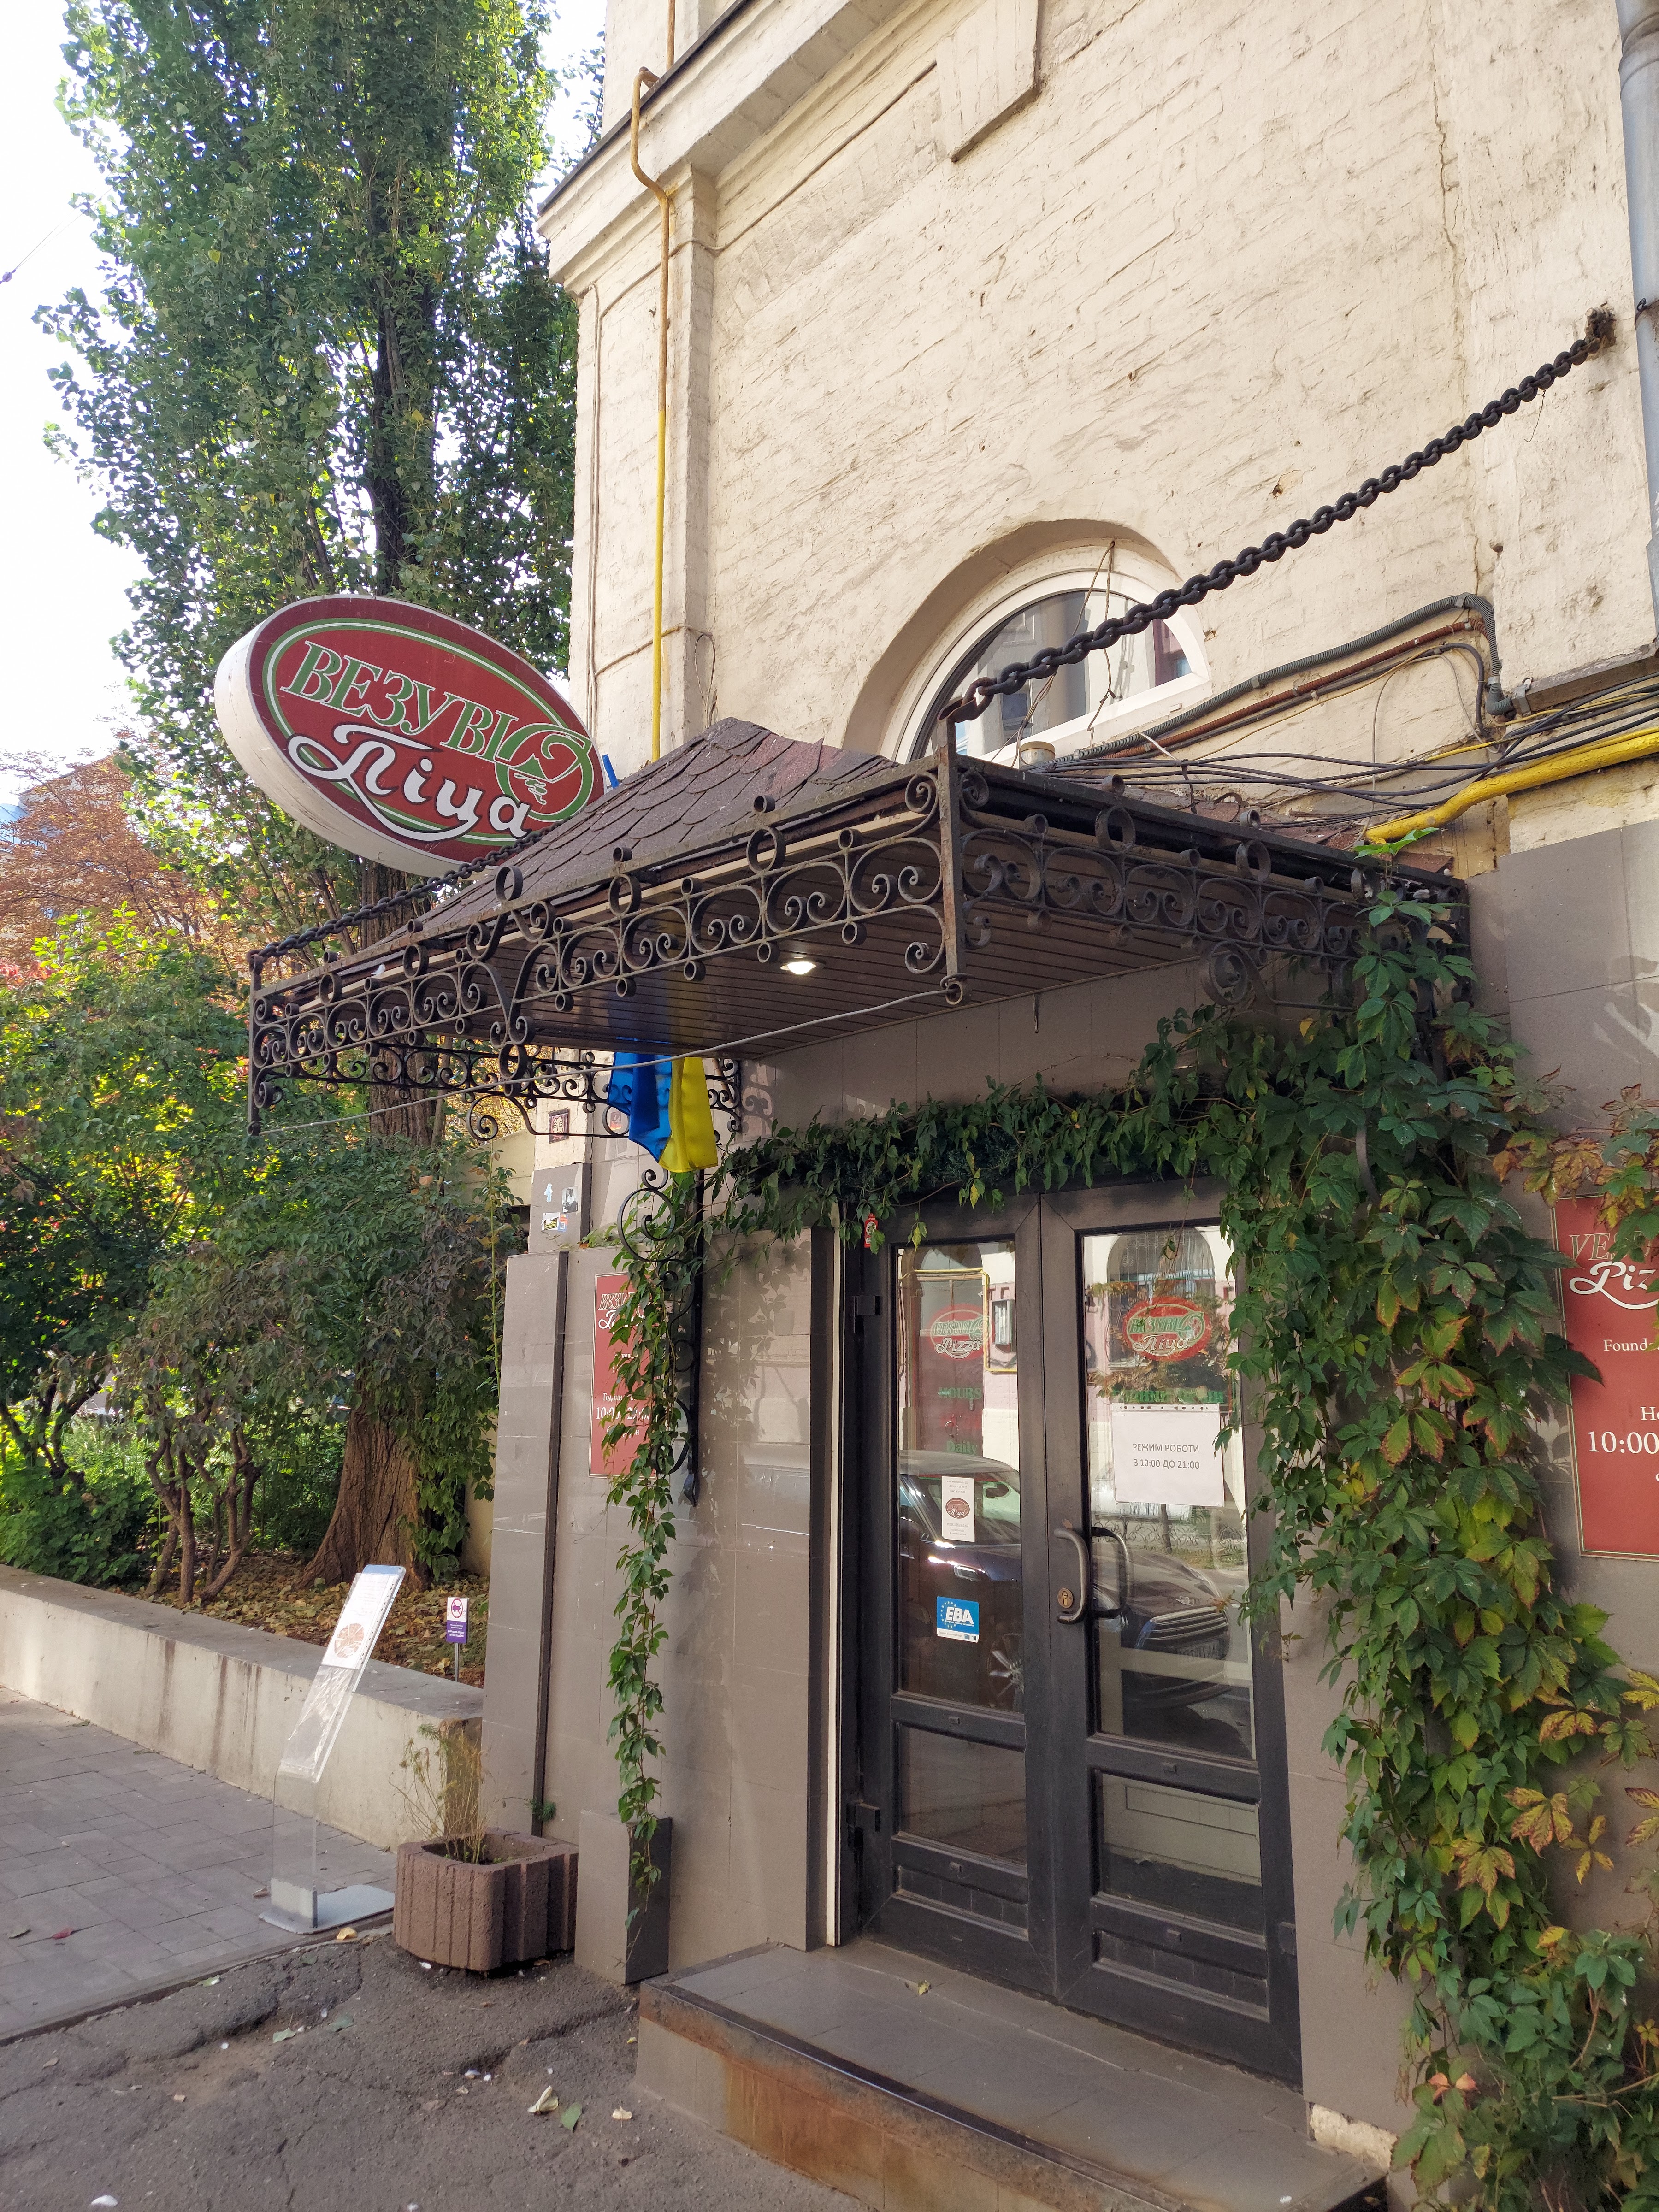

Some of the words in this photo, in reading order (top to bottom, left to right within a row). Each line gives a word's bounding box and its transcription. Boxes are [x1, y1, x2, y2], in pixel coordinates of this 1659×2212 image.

[280, 640, 594, 822] ВЕЗУВІО
[288, 723, 533, 843] Піца
[935, 1337, 981, 1359] Pizza
[1132, 1334, 1189, 1357] Піца
[939, 1387, 982, 1399] HOURS
[946, 1440, 978, 1456] Daily
[1133, 1443, 1163, 1451] РЕЖИМ
[1165, 1444, 1199, 1453] РОБОТИ
[1588, 1431, 1659, 1454] 10:00
[1140, 1459, 1160, 1467] 10:00
[1162, 1460, 1175, 1469] ДО
[1177, 1460, 1200, 1469] 21:00
[945, 1606, 974, 1624] EBA
